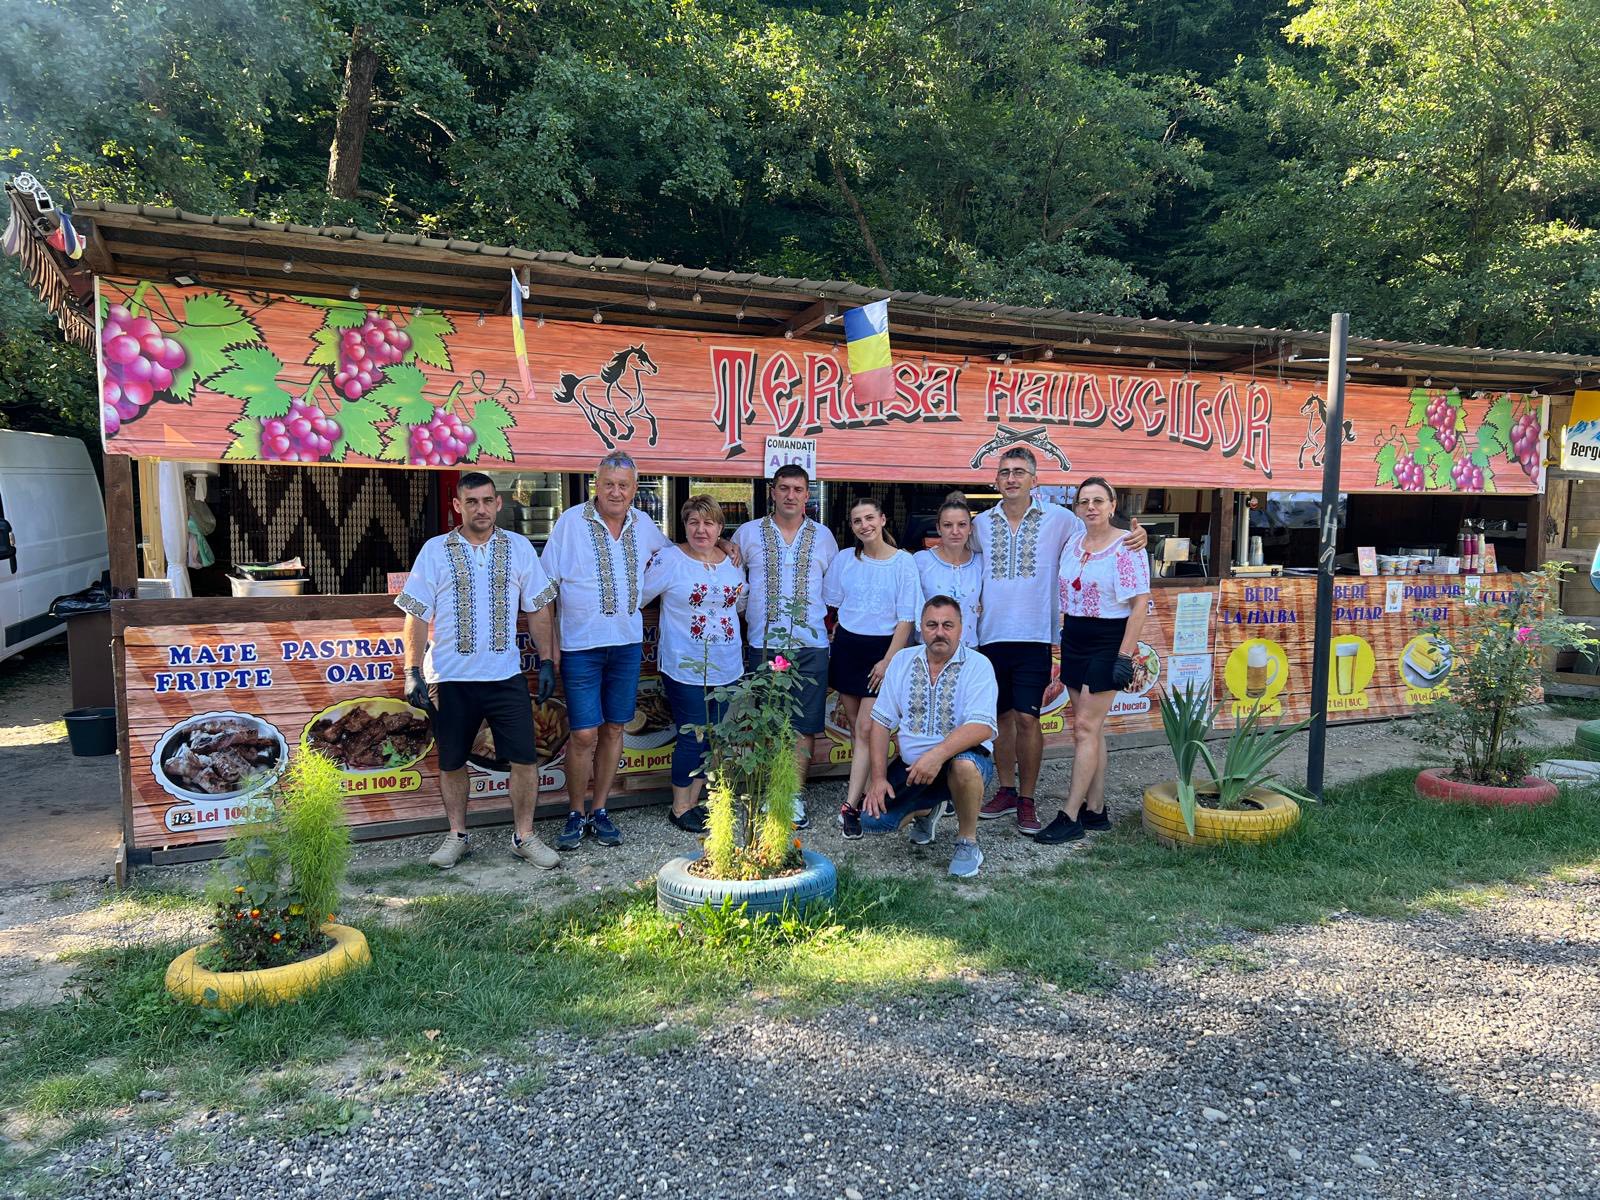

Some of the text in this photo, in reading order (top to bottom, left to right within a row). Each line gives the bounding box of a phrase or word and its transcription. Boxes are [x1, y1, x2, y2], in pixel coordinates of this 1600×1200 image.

[984, 367, 1272, 477] HAIDUCILOR
[1570, 441, 1600, 460] Berg
[1244, 586, 1282, 602] BERE
[1333, 584, 1368, 600] BERE
[1223, 609, 1242, 625] LA
[1335, 606, 1383, 621] PAHAR
[168, 643, 259, 666] MATE
[155, 662, 394, 693] FRIPTE OAIE
[1041, 721, 1058, 731] cata
[627, 755, 645, 769] Lei
[647, 753, 672, 769] port
[836, 750, 847, 760] 12
[345, 778, 367, 792] Lei
[371, 775, 397, 790] 100
[475, 780, 486, 792] 8
[173, 811, 193, 825] 14
[196, 808, 219, 823] Lei
[223, 805, 250, 821] 100
